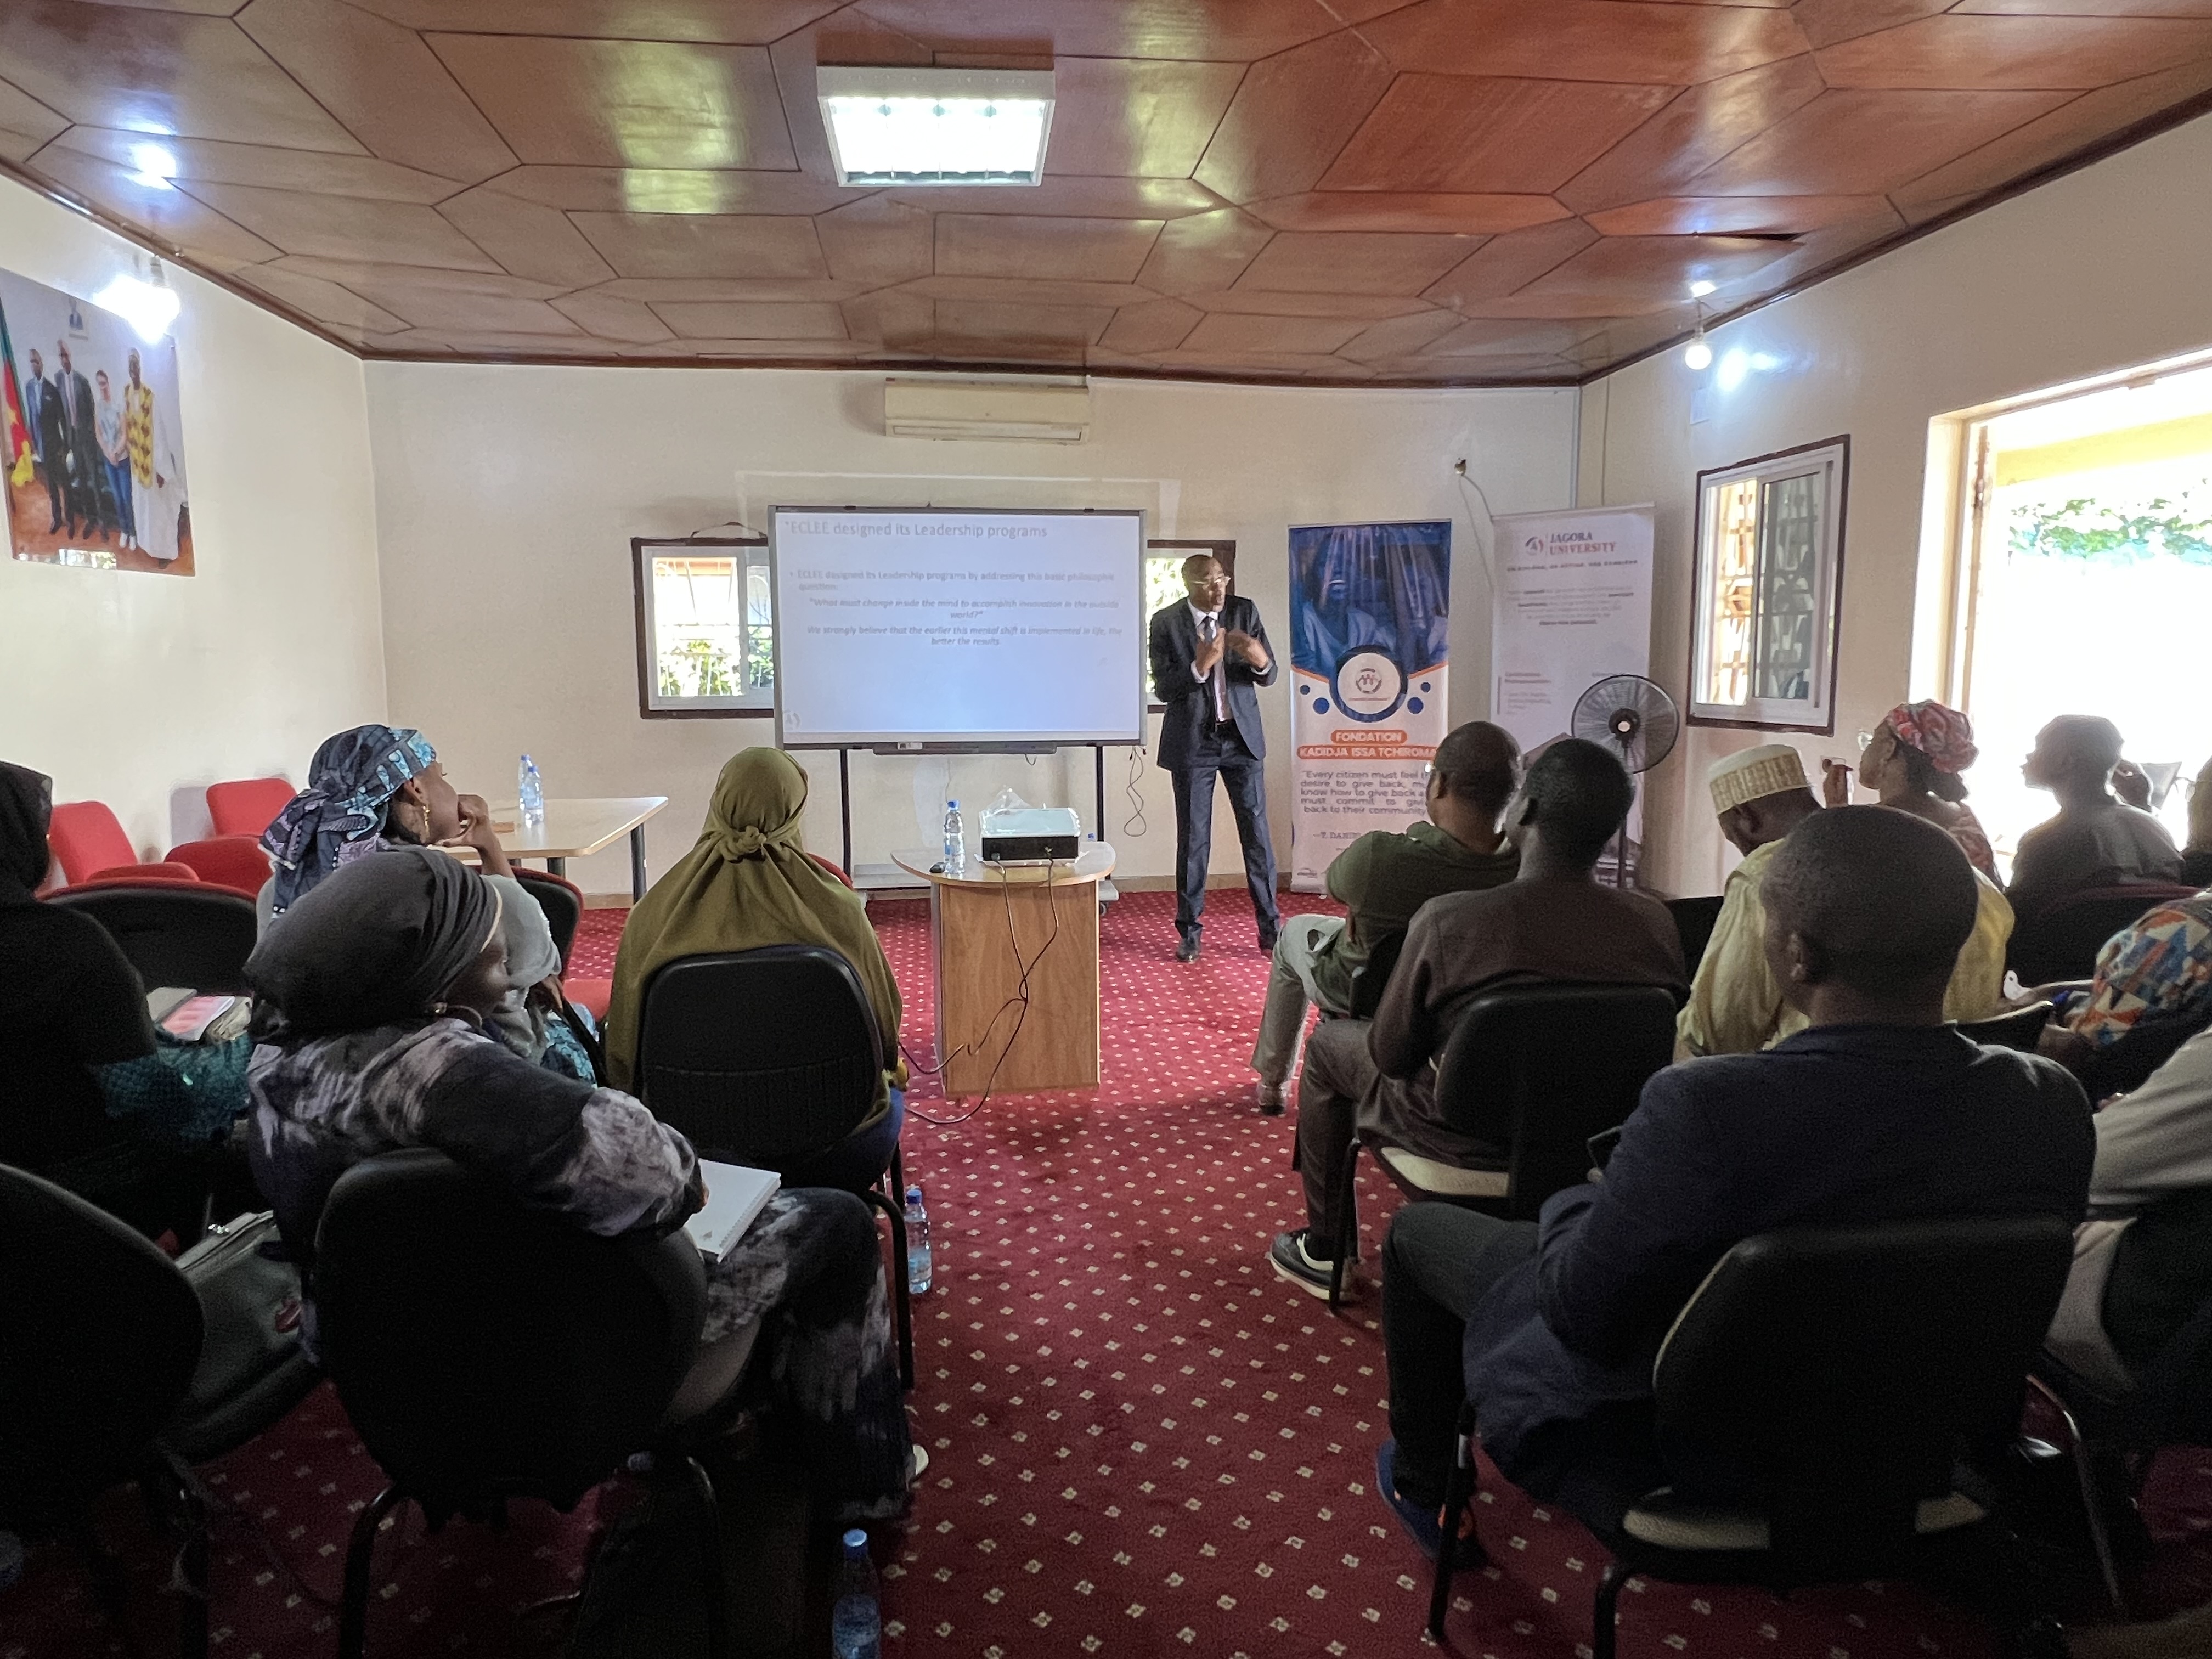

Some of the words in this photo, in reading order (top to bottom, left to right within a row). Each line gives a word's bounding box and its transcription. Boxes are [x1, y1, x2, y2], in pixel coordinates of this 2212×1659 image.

[791, 521, 830, 535] ECLEE
[833, 522, 891, 538] designed
[896, 523, 910, 535] its
[915, 524, 983, 539] Leadership
[988, 526, 1047, 539] programs
[1550, 541, 1616, 555] UNIVERSITY
[825, 571, 863, 580] designed
[866, 571, 876, 579] its
[878, 571, 924, 581] Leadership
[927, 572, 966, 581] programs
[969, 571, 978, 580] by
[981, 572, 1025, 582] addressing
[1028, 572, 1042, 580] this
[840, 599, 860, 607] must
[863, 599, 893, 609] change
[895, 599, 919, 607] inside
[922, 599, 935, 607] the
[972, 600, 1017, 608] accomplish
[823, 626, 856, 635] strongly
[859, 626, 887, 634] believe
[970, 626, 999, 634] mental
[1000, 626, 1018, 635] shift
[1029, 627, 1081, 635] implemented
[1336, 732, 1402, 742] FONDATION
[1300, 747, 1348, 757] KADIDJA
[1352, 748, 1376, 757] ISSA
[1368, 790, 1389, 798] give
